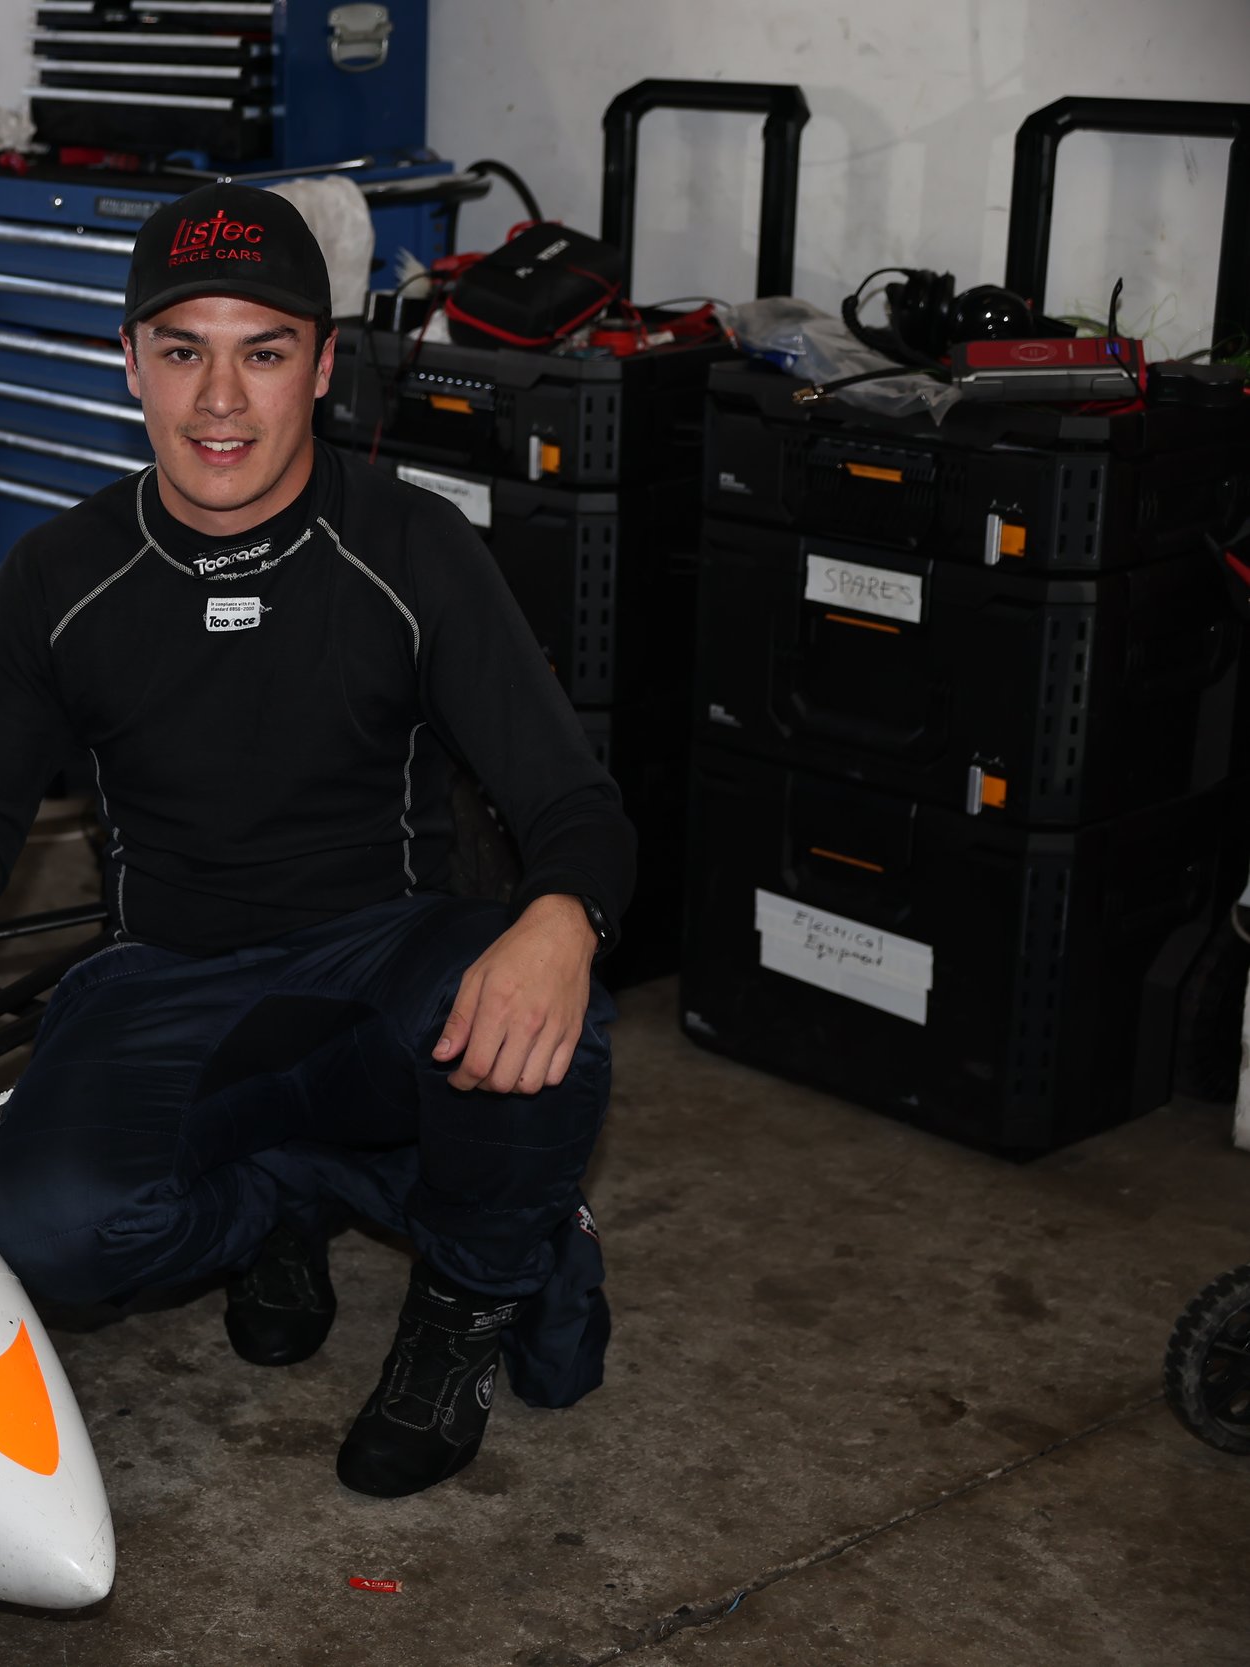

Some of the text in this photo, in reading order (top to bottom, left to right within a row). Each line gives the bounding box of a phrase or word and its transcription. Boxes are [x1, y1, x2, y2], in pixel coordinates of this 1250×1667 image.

[169, 249, 263, 267] RACE CARS
[822, 567, 915, 606] SPARES
